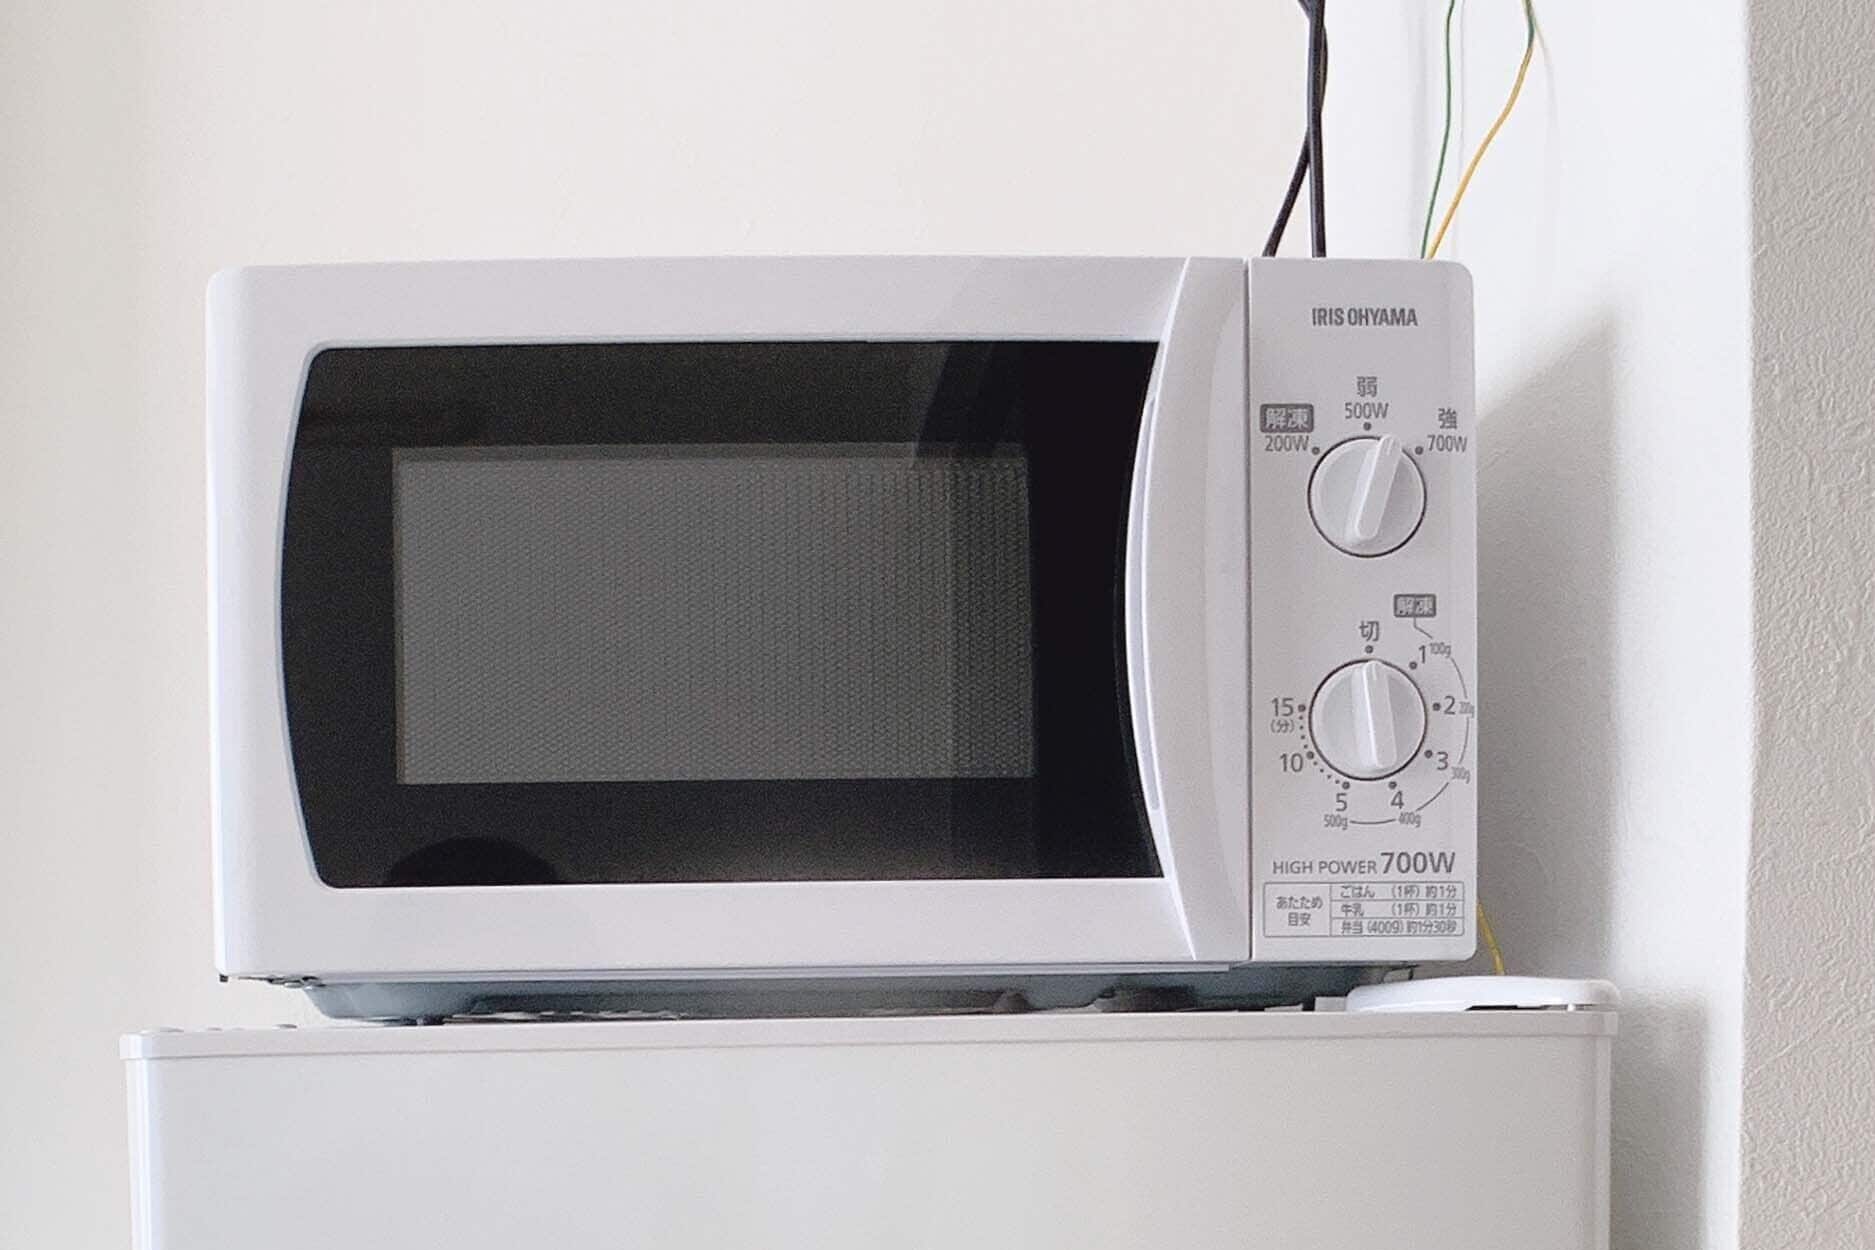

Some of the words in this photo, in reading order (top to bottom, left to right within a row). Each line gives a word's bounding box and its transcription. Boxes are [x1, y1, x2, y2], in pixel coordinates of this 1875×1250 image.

[1312, 308, 1344, 326] IRIS
[1348, 308, 1418, 326] OHYAMA
[1357, 376, 1377, 397] 弱
[1263, 407, 1311, 430] 解凍
[1344, 402, 1389, 419] 500W
[1437, 408, 1458, 429] 強
[1265, 435, 1309, 452] 200W
[1428, 435, 1468, 452] 700W
[1360, 620, 1380, 642] 切
[1418, 645, 1427, 664] 1
[1271, 697, 1294, 717] 15
[1443, 695, 1456, 715] 2
[1280, 752, 1303, 773] 10
[1436, 751, 1449, 771] 3
[1335, 792, 1347, 812] 5
[1390, 790, 1404, 809] 4
[1272, 861, 1313, 874] HIGH
[1318, 861, 1378, 875] POWER
[1379, 852, 1456, 874] 700W
[1340, 885, 1375, 898] ごはん
[1276, 896, 1324, 910] あたため
[1287, 913, 1312, 927] 目安
